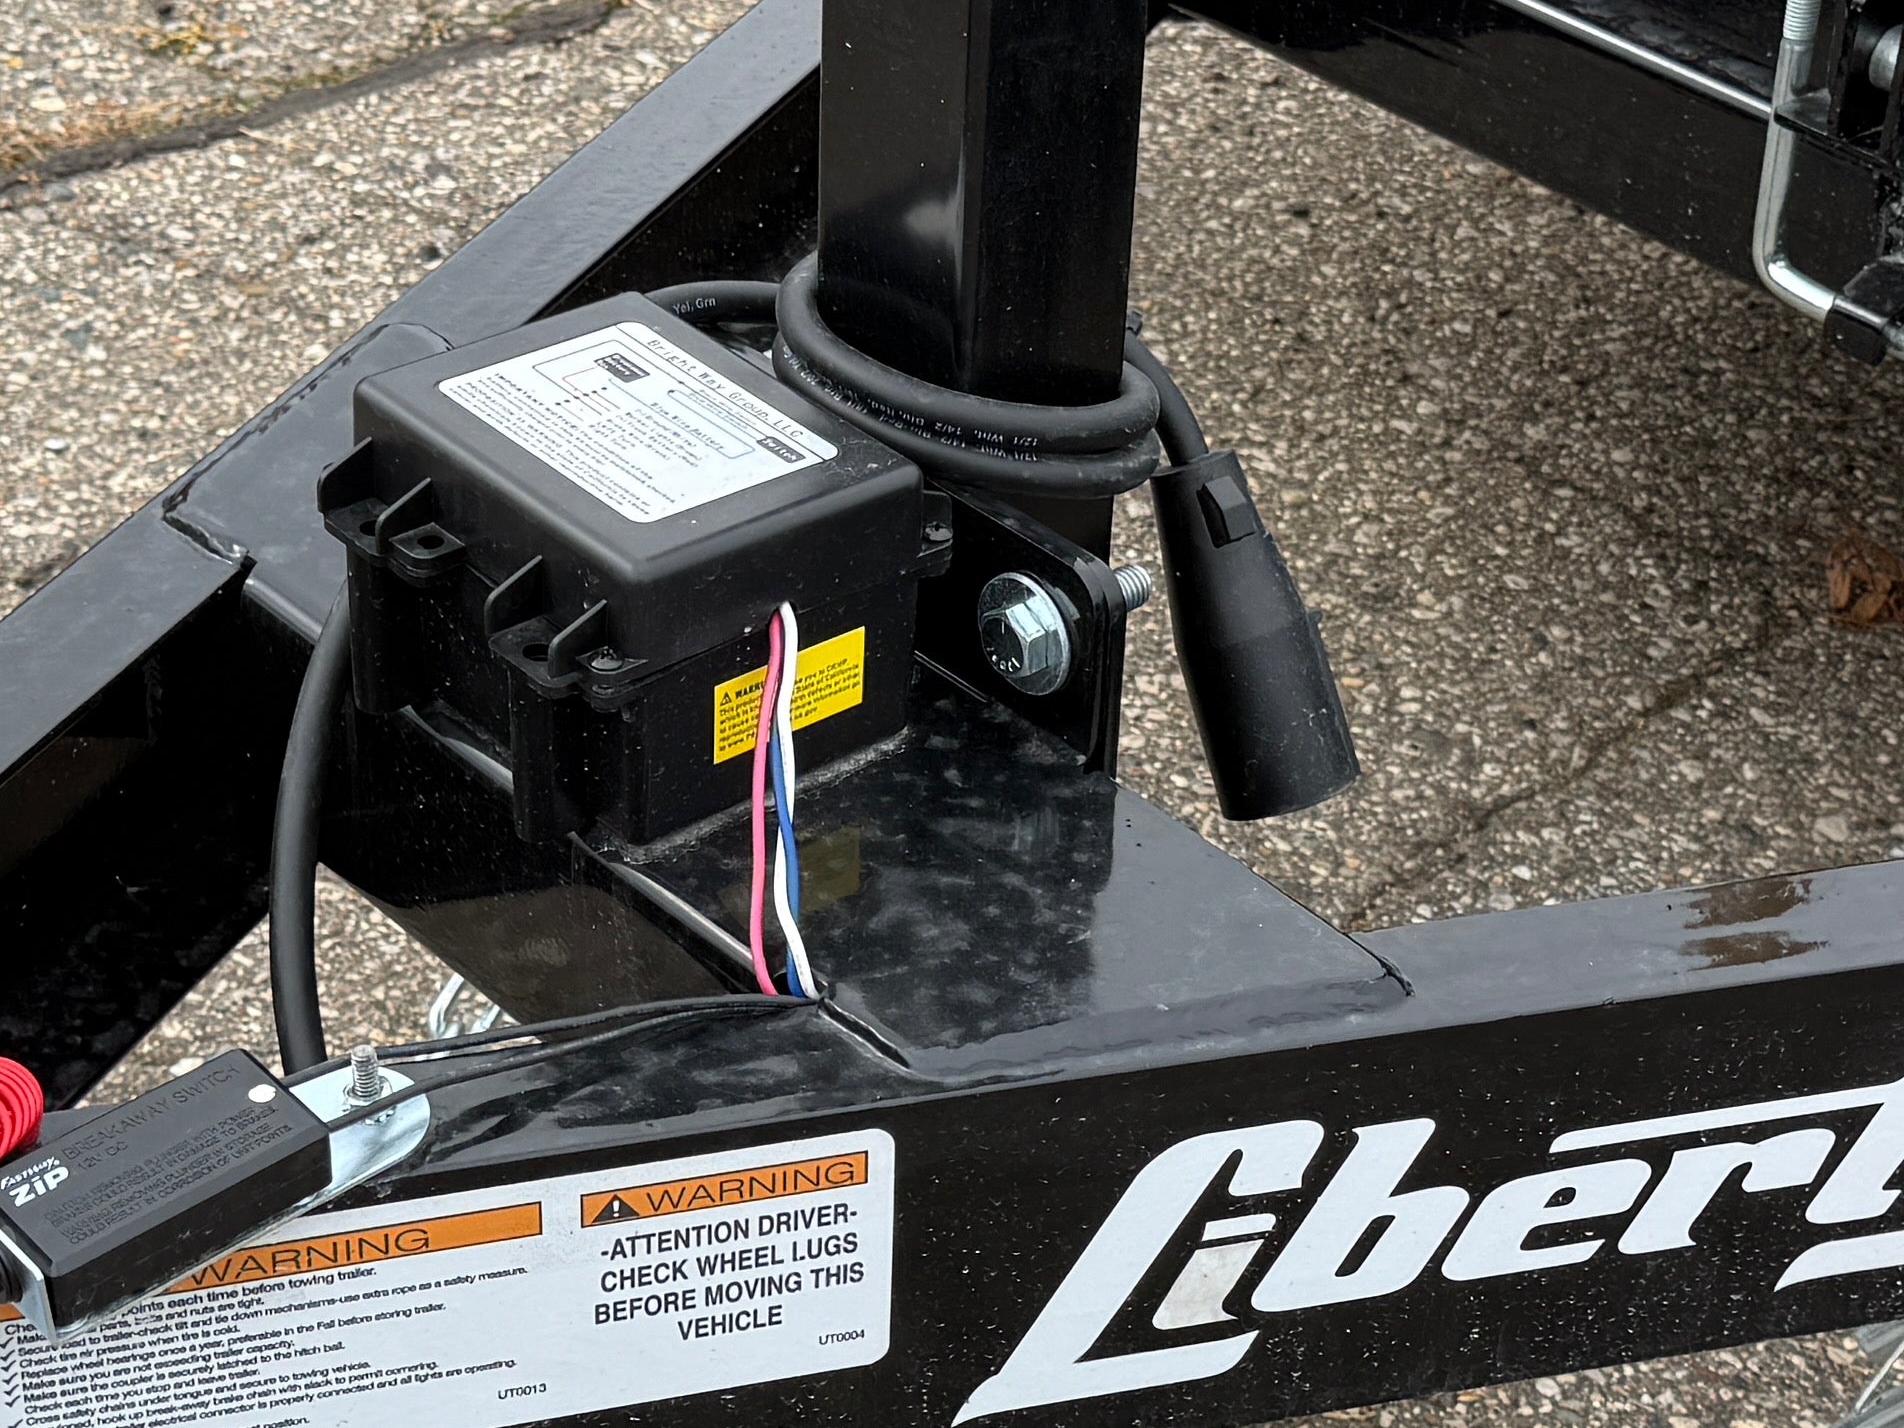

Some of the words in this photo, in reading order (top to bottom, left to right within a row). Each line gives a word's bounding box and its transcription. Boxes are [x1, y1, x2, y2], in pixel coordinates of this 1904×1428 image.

[696, 297, 716, 308] Grn
[60, 1095, 171, 1160] BREAKAWAY
[172, 1064, 239, 1105] SWITCH
[646, 1161, 855, 1213] WARNING
[191, 1227, 430, 1286] WARNING
[601, 1219, 750, 1259] -ATTENTION
[758, 1205, 857, 1237] DRIVER-
[168, 1291, 203, 1309] each
[207, 1287, 238, 1303] time
[242, 1281, 285, 1297] before
[288, 1272, 334, 1289] towing
[337, 1264, 376, 1281] trailer.
[600, 1260, 689, 1293] CHECK
[696, 1244, 784, 1277] WHEEL
[792, 1232, 859, 1262] LUGS
[595, 1289, 697, 1324] BEFORE
[704, 1273, 802, 1307] MOVING
[810, 1263, 865, 1290] THIS
[677, 1305, 783, 1341] VEHICLE
[818, 1330, 865, 1346] UT0004
